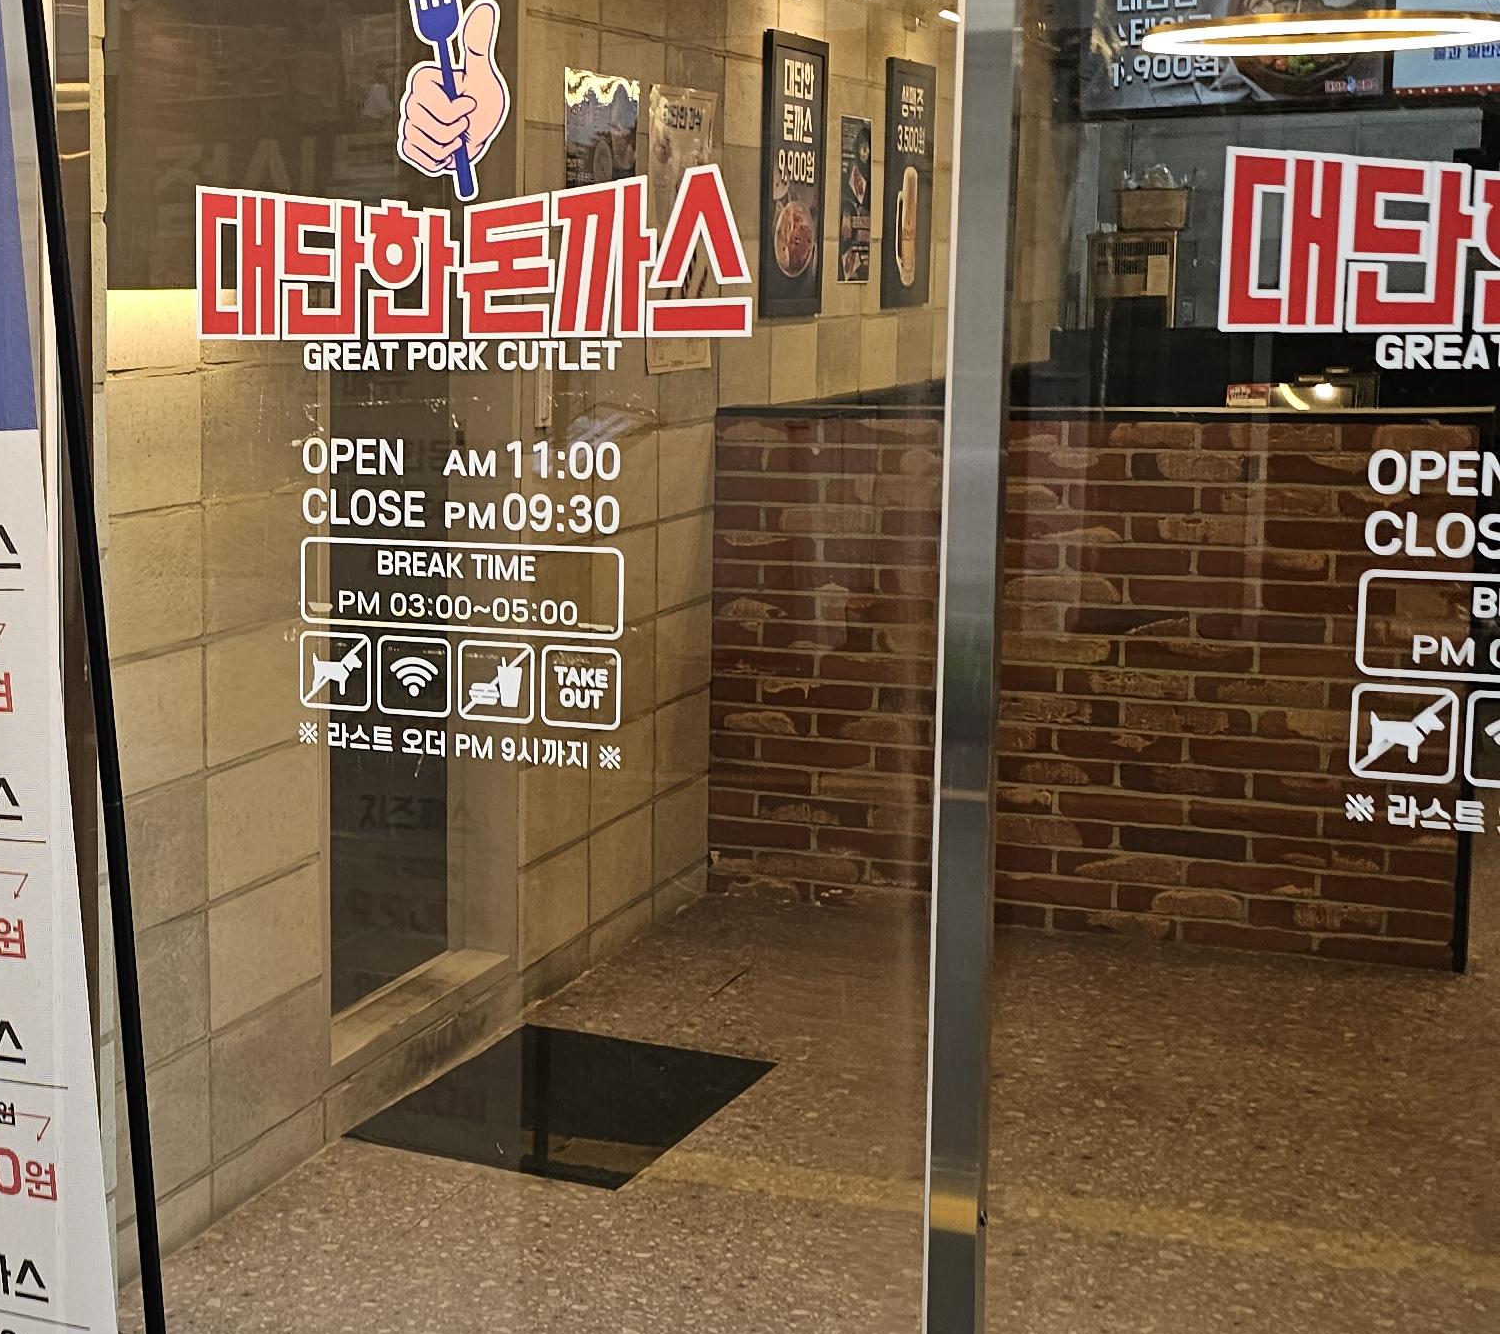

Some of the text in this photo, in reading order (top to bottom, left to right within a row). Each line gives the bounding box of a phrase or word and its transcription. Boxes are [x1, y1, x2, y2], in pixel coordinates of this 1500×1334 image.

[784, 58, 814, 100] 대단한
[784, 103, 812, 143] 돈까스
[195, 163, 753, 340] 대단한돈까스
[303, 340, 622, 371] GREAT PORK CUTLET
[302, 438, 621, 481] OPEN AM 11:00
[302, 487, 620, 535] CLOSE PM 09:30
[377, 550, 536, 582] BREAK TIME
[338, 590, 578, 626] PM 03:00~05:00
[1412, 634, 1475, 666] PM
[553, 666, 609, 689] TAKE
[559, 689, 604, 710] OUT
[327, 722, 393, 752] 라스트
[401, 728, 446, 757] 오더
[455, 734, 493, 760] PM
[501, 737, 588, 769] 9시까지
[1387, 794, 1485, 833] 라스트
